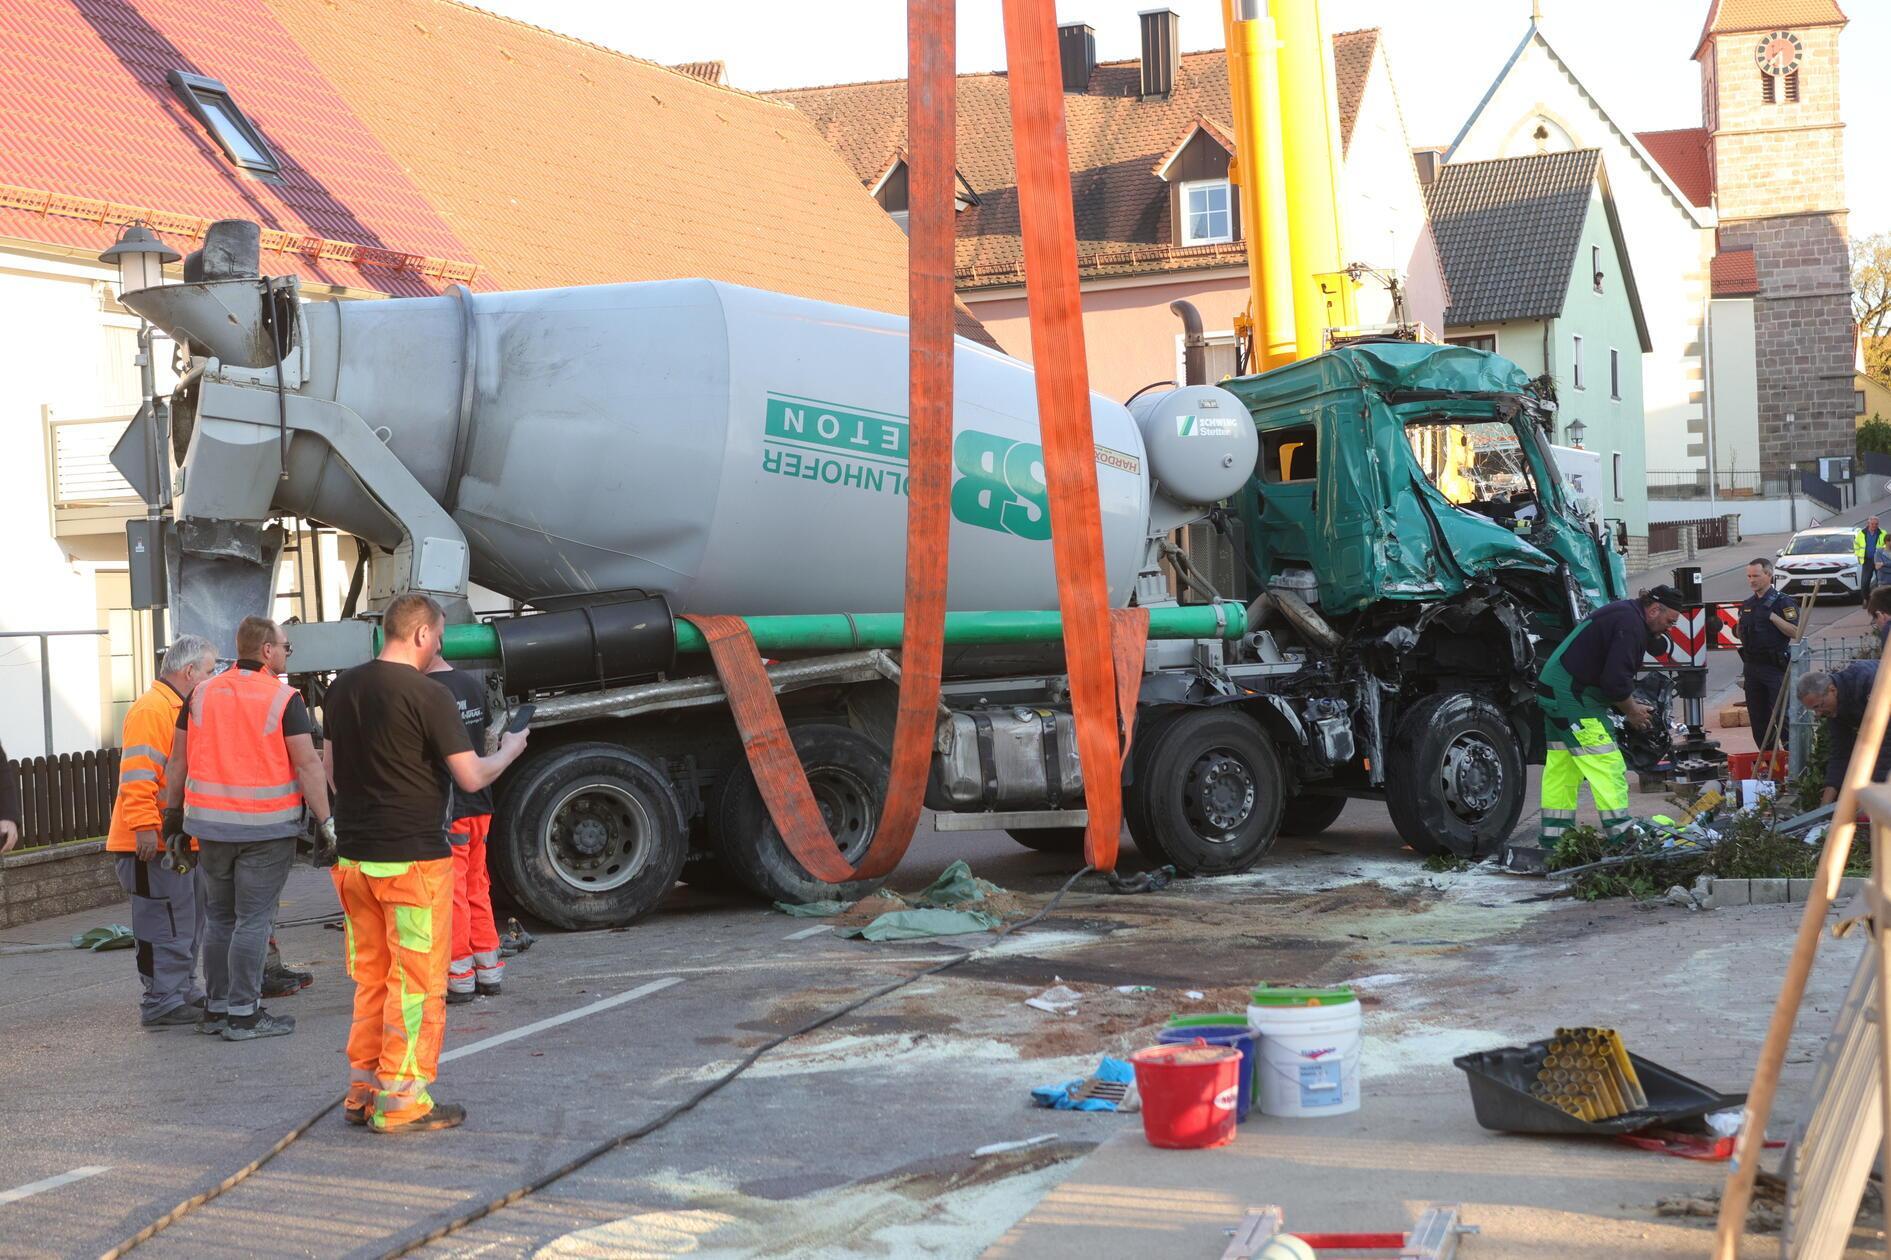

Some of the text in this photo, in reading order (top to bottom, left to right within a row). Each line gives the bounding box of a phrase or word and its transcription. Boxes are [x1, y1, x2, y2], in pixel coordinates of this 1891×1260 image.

[783, 407, 900, 451] ETON
[762, 448, 910, 497] LNHOFER
[950, 429, 1053, 541] SB
